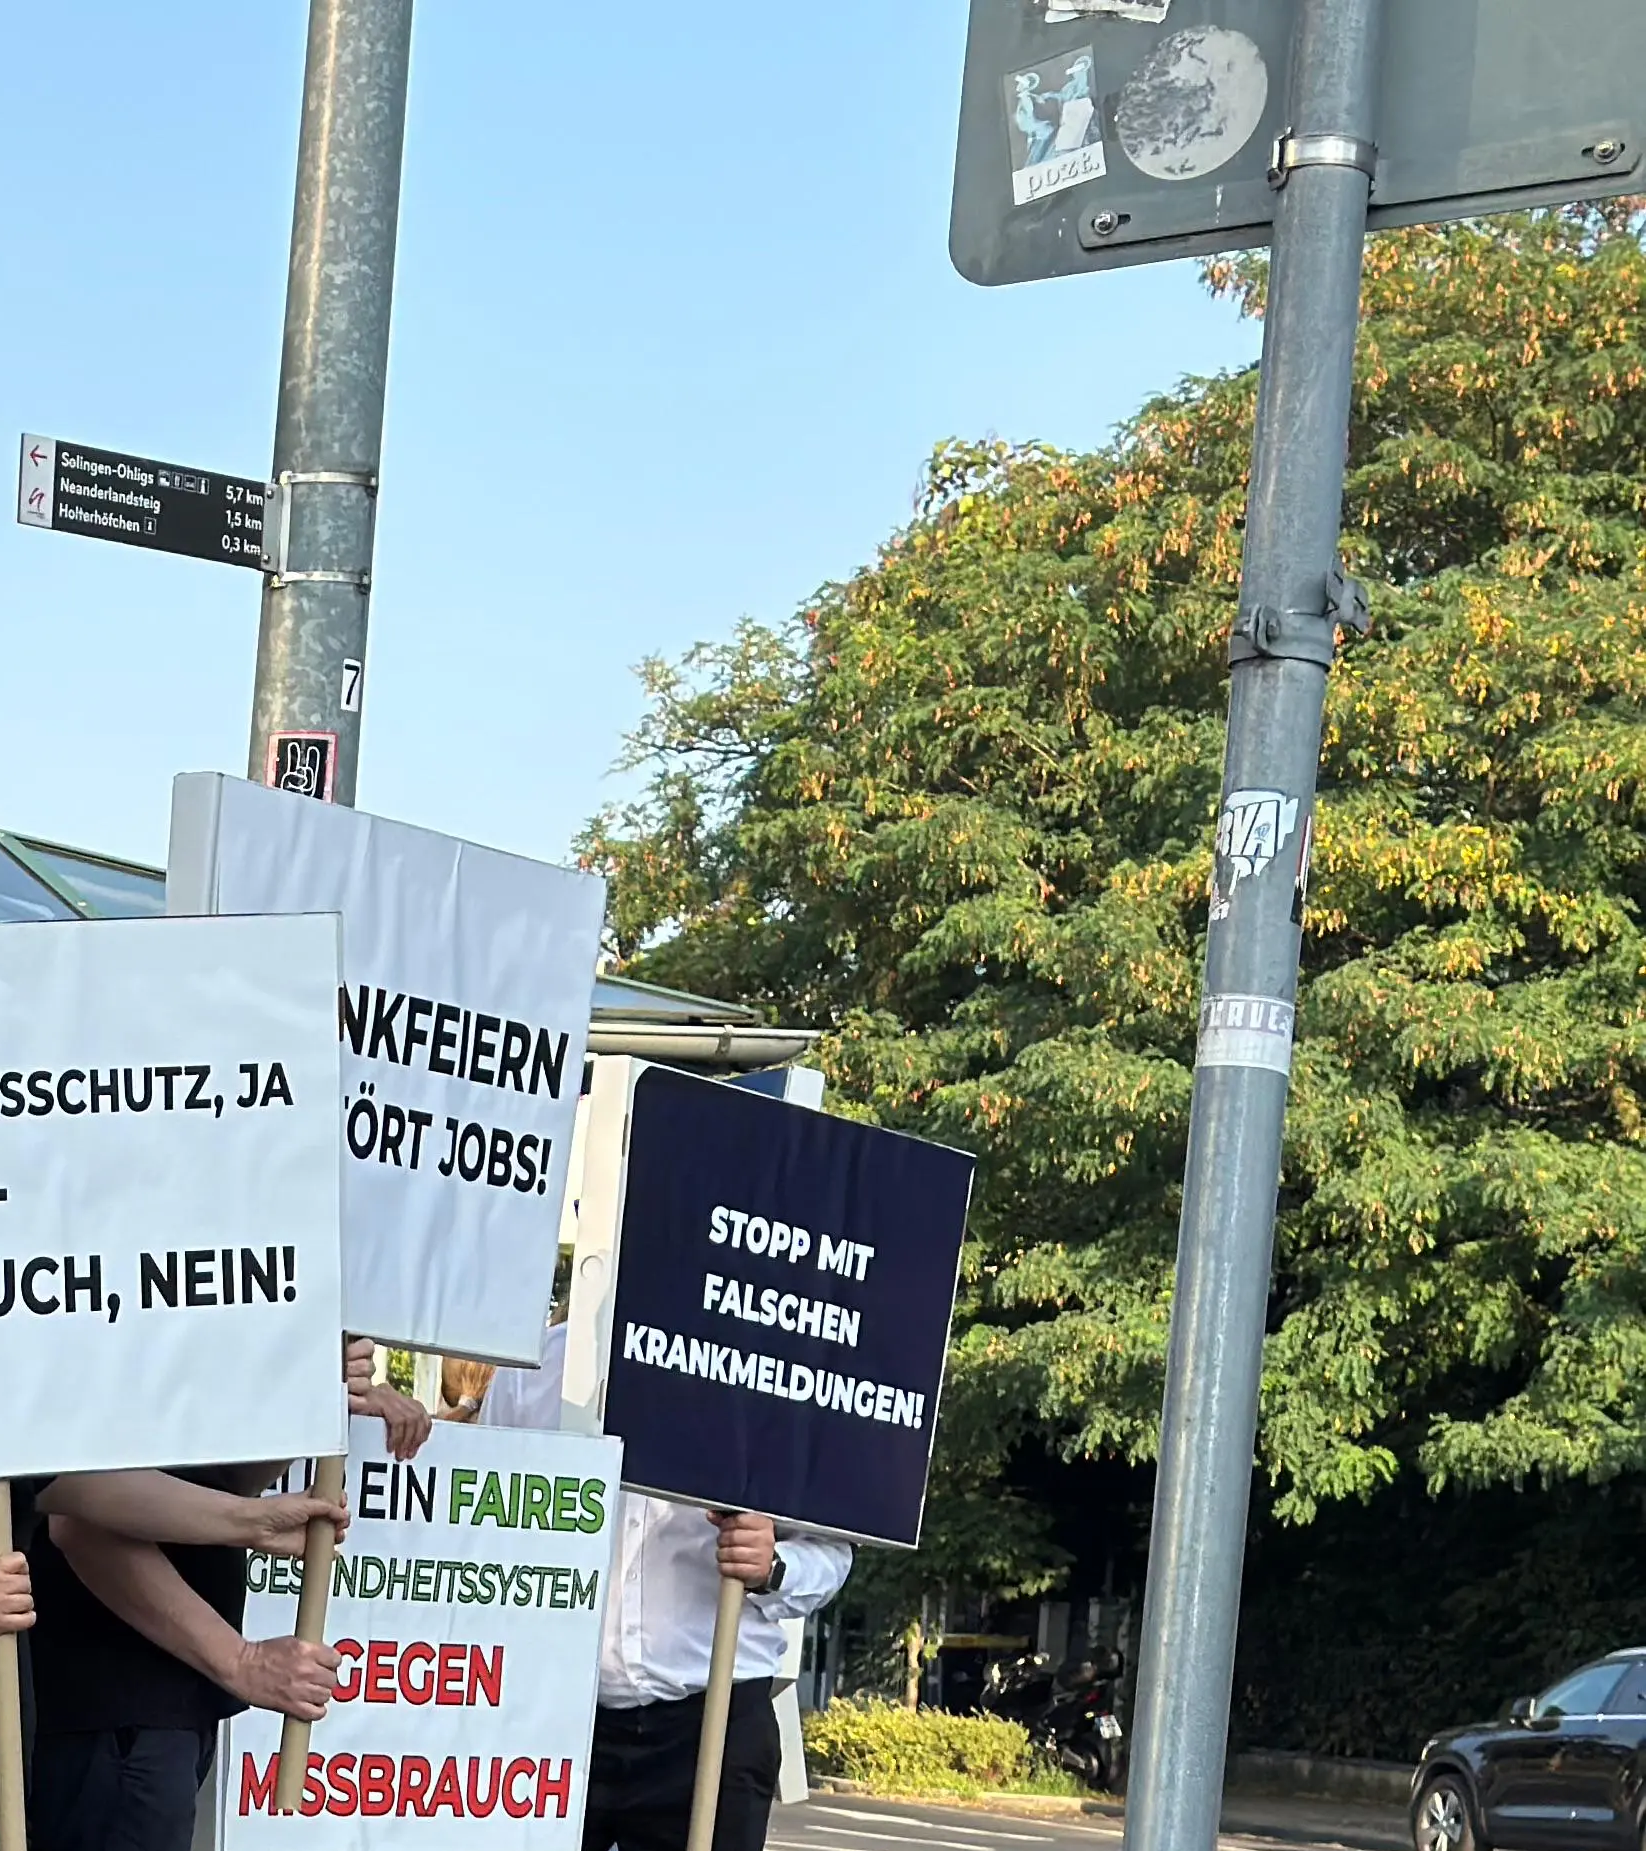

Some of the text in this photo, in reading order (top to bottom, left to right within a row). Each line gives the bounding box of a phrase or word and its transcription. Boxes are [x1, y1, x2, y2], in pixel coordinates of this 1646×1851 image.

[60, 477, 262, 531] Neanderlandsteig 1,5 km
[61, 451, 263, 506] Solingen-Ohligs 5,7 km
[59, 502, 140, 533] Holterhöfchen
[222, 534, 240, 554] 0,3
[243, 543, 261, 556] km
[345, 663, 359, 705] 7
[237, 1062, 294, 1108] JA
[345, 1081, 552, 1195] ÖRT JOBS!
[709, 1206, 875, 1281] STOPP MIT
[139, 1245, 296, 1310] NEIN!
[703, 1273, 861, 1347] FALSCHEN
[623, 1322, 924, 1430] KRANKMELDUNGEN!
[358, 1462, 436, 1523] EIN
[449, 1468, 606, 1534] FAIRES
[246, 1552, 599, 1610] GESNDHEITSSYSTEM
[332, 1638, 504, 1706] GEGEN
[239, 1751, 572, 1818] MSSBRAUCH
